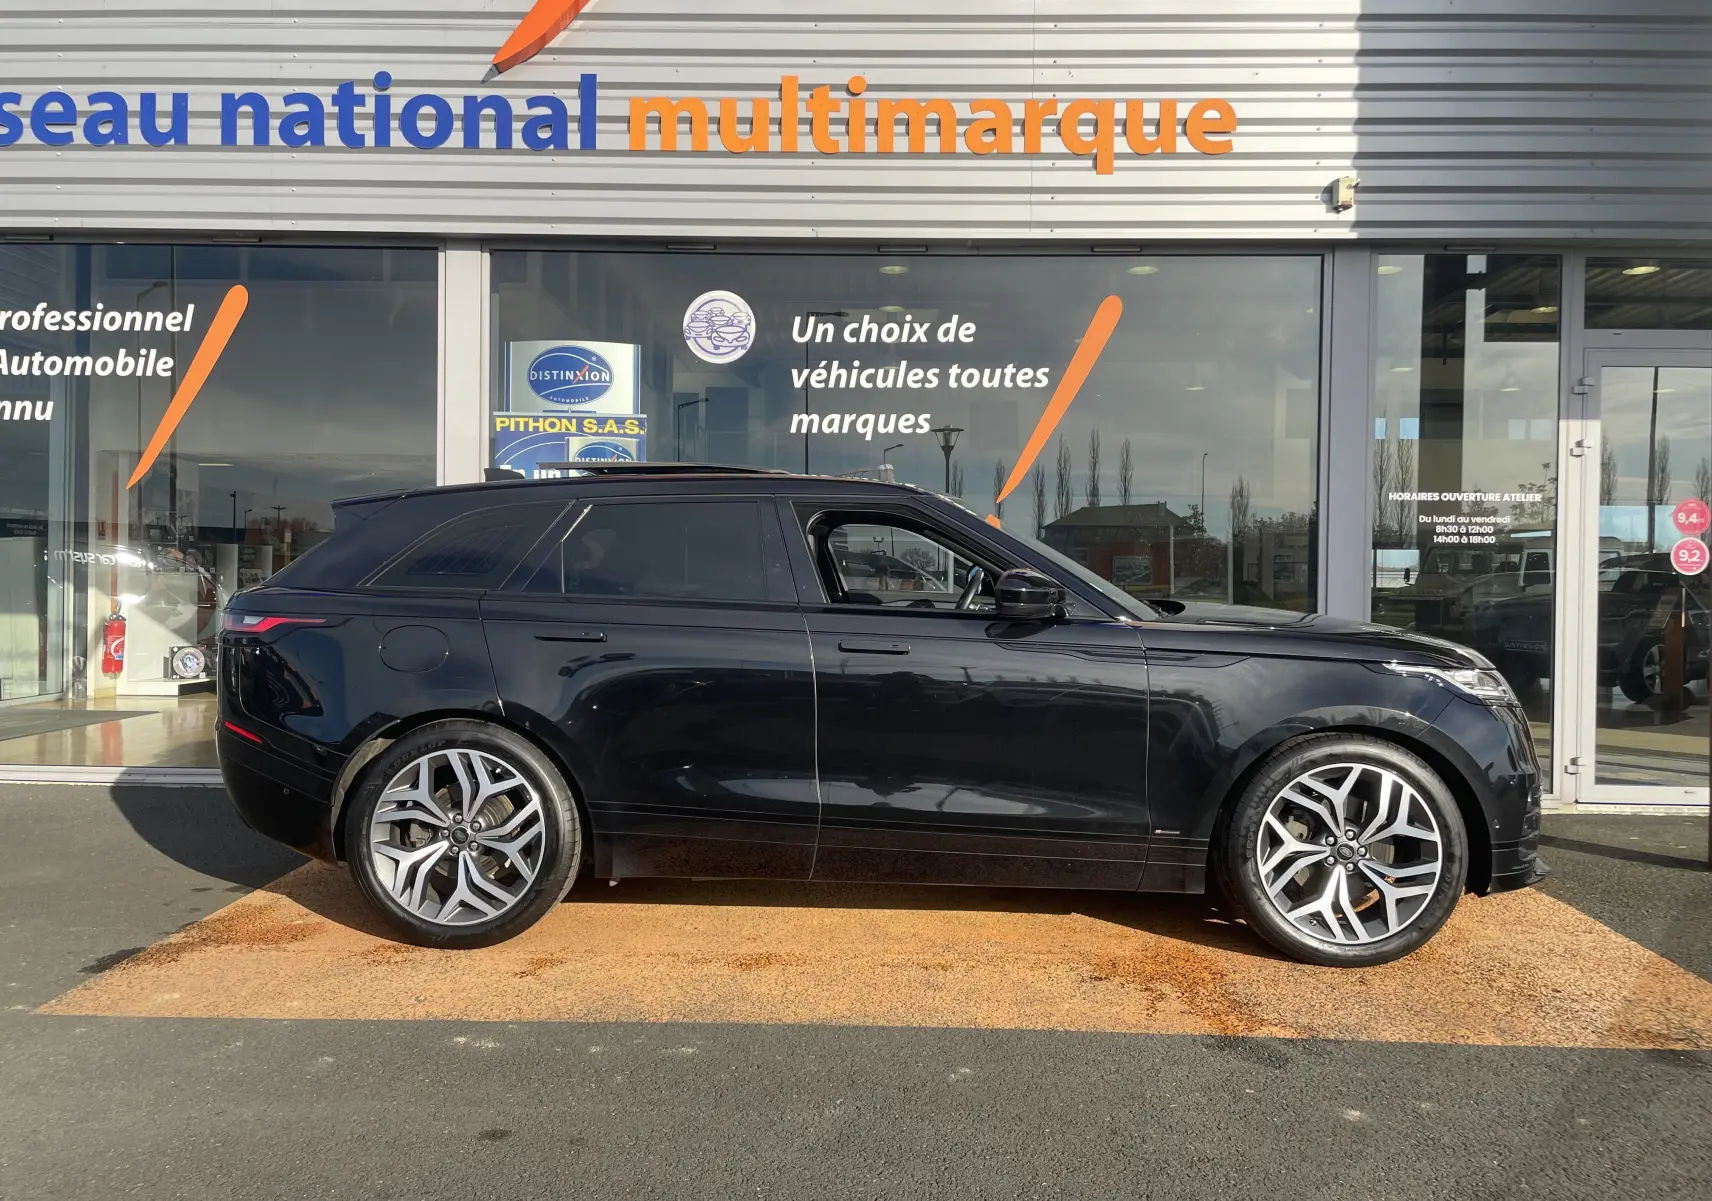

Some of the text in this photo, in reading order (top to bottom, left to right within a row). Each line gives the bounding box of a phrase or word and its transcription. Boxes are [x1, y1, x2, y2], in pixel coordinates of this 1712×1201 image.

[0, 71, 1237, 175] seau national multimarque
[0, 302, 195, 332] rofessionnel
[792, 314, 977, 344] Un choix de
[0, 348, 174, 377] Automobile
[530, 369, 610, 382] DISTINXION
[791, 360, 1050, 389] véhicules toutes
[550, 395, 589, 403] AUTOMOBILE
[495, 417, 645, 435] PITHON S.A.S.
[790, 413, 931, 441] marques
[1388, 492, 1543, 502] HORAIRES OUVERTURE ATELIER
[1418, 515, 1431, 523] Du
[1433, 514, 1456, 523] lundi
[1471, 515, 1511, 524] vendredi
[1677, 512, 1698, 526] 9,4
[1435, 525, 1494, 534] 8h30 à 12h00
[1433, 535, 1496, 544] 14h00 à 18h00
[1678, 549, 1701, 564] 9,2
